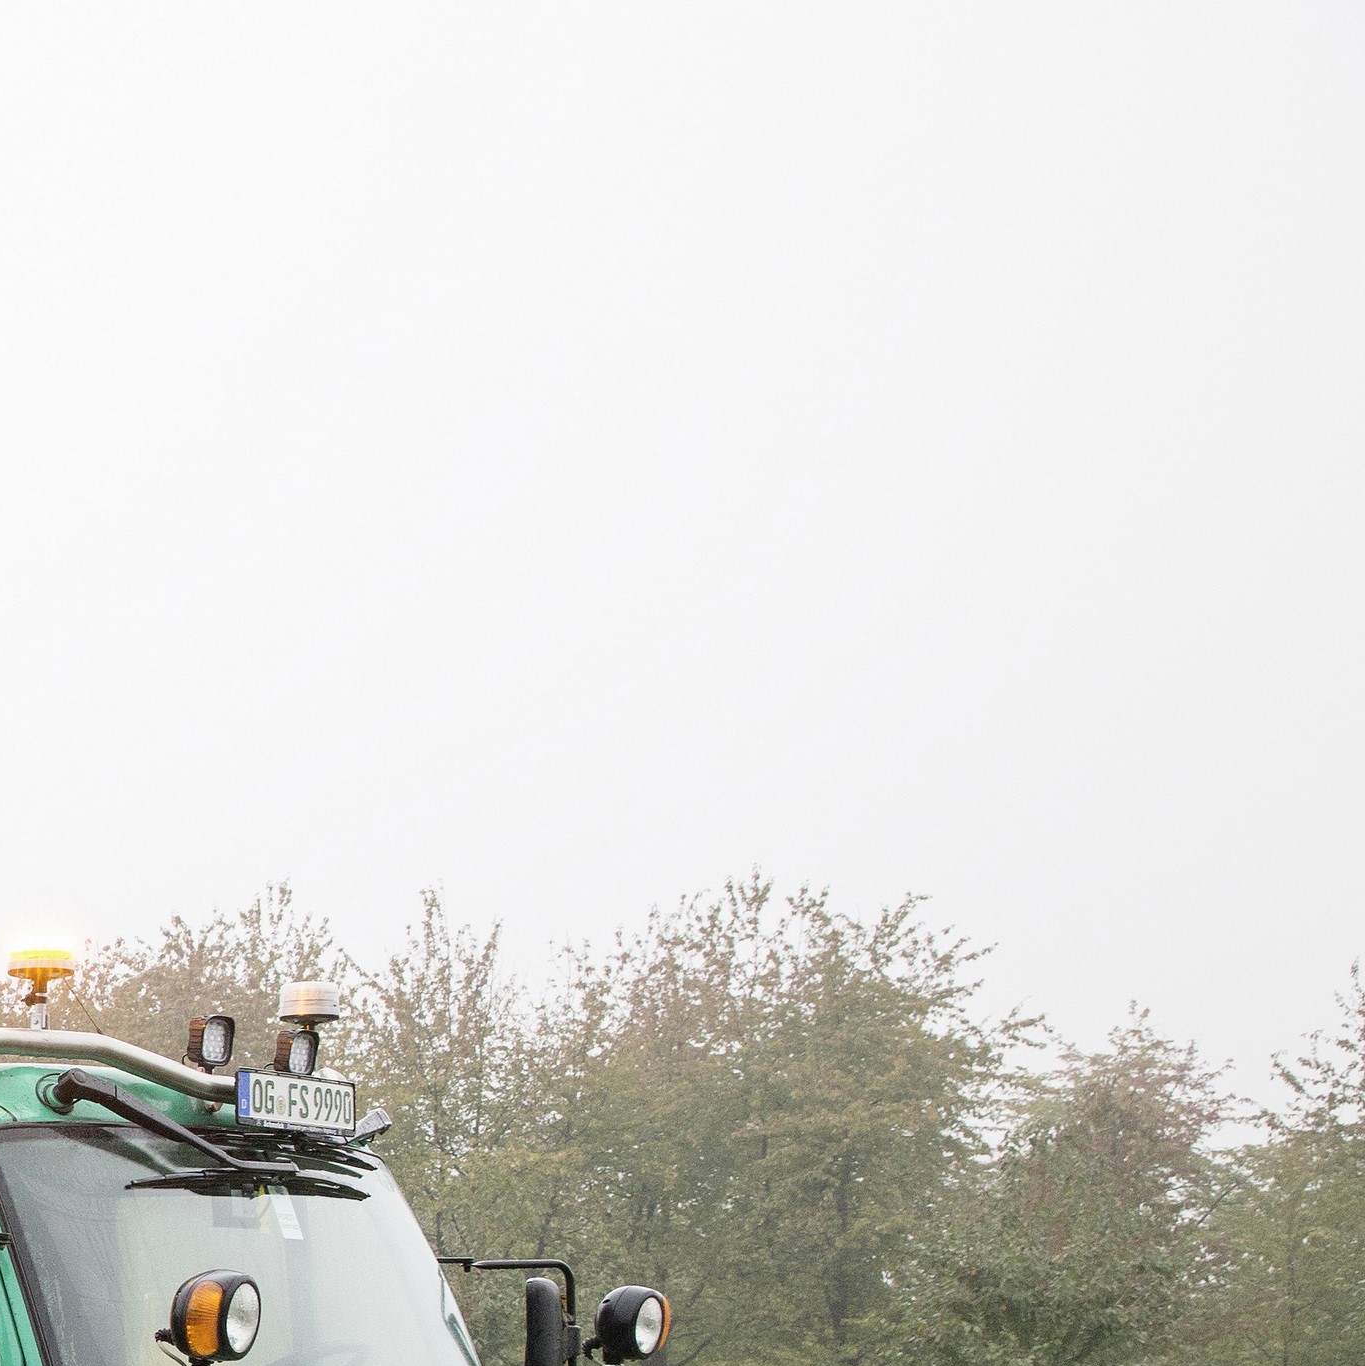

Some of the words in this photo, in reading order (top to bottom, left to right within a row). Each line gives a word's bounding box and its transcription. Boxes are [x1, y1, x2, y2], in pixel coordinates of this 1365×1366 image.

[252, 1078, 275, 1115] OG
[288, 1082, 309, 1119] FS
[314, 1086, 352, 1124] 9990
